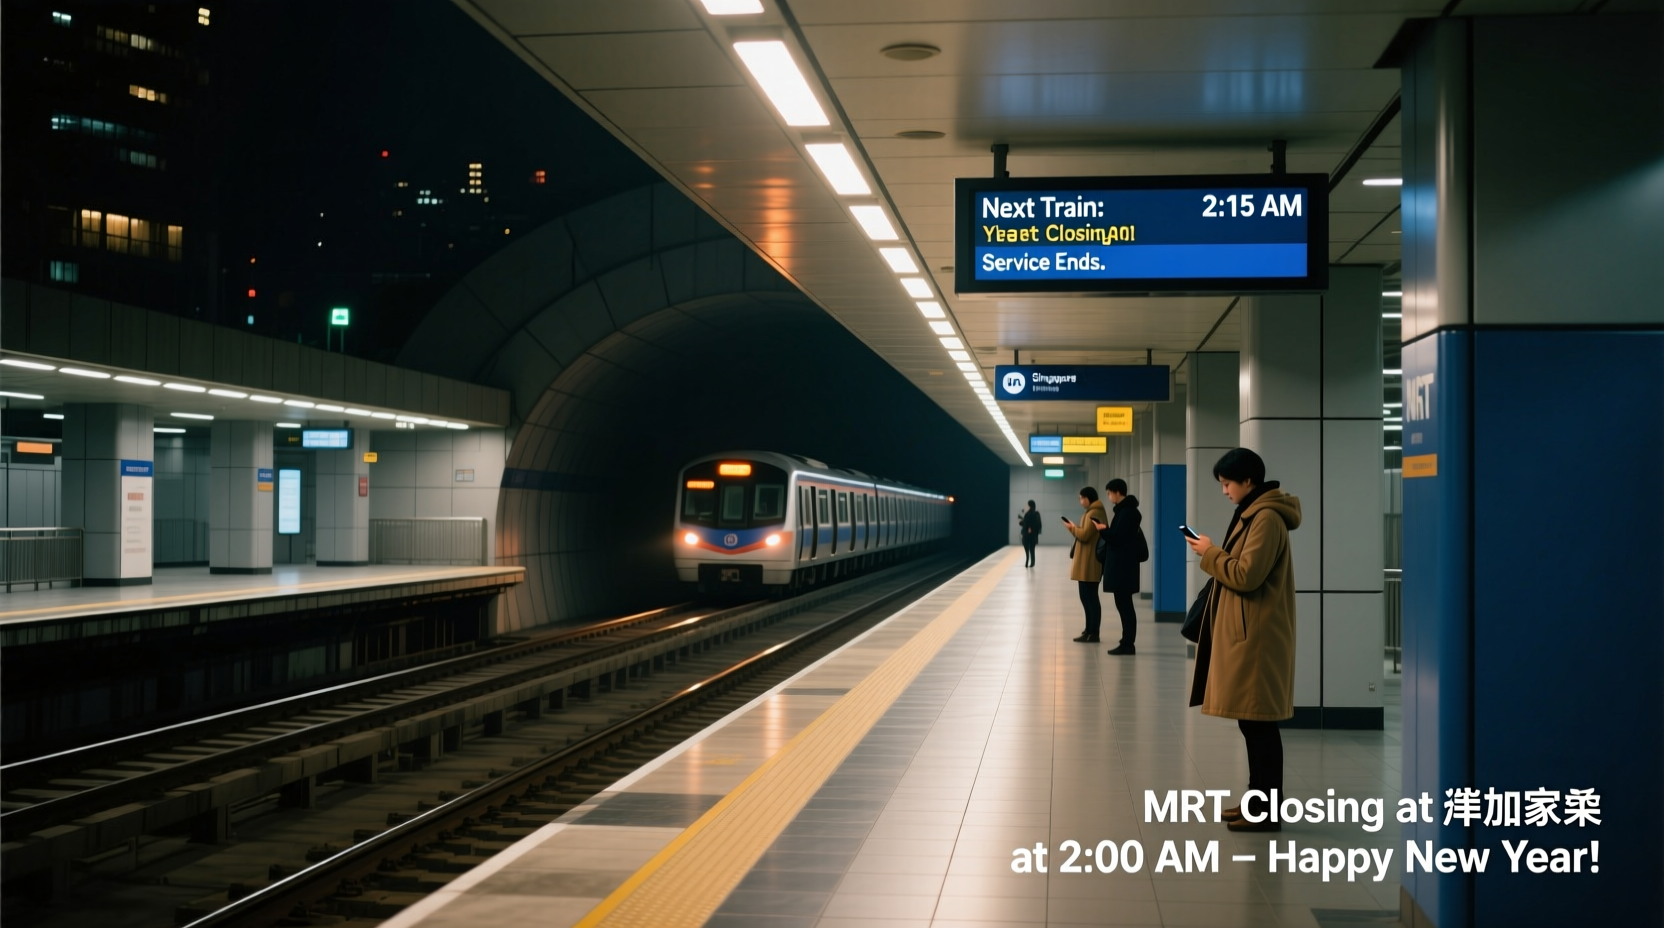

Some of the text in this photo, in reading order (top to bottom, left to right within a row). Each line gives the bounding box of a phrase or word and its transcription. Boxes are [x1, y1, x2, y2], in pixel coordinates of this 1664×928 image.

[982, 196, 1104, 219] Next Train:
[1202, 193, 1302, 217] 2:15 AM
[982, 252, 1107, 272] Service Ends.
